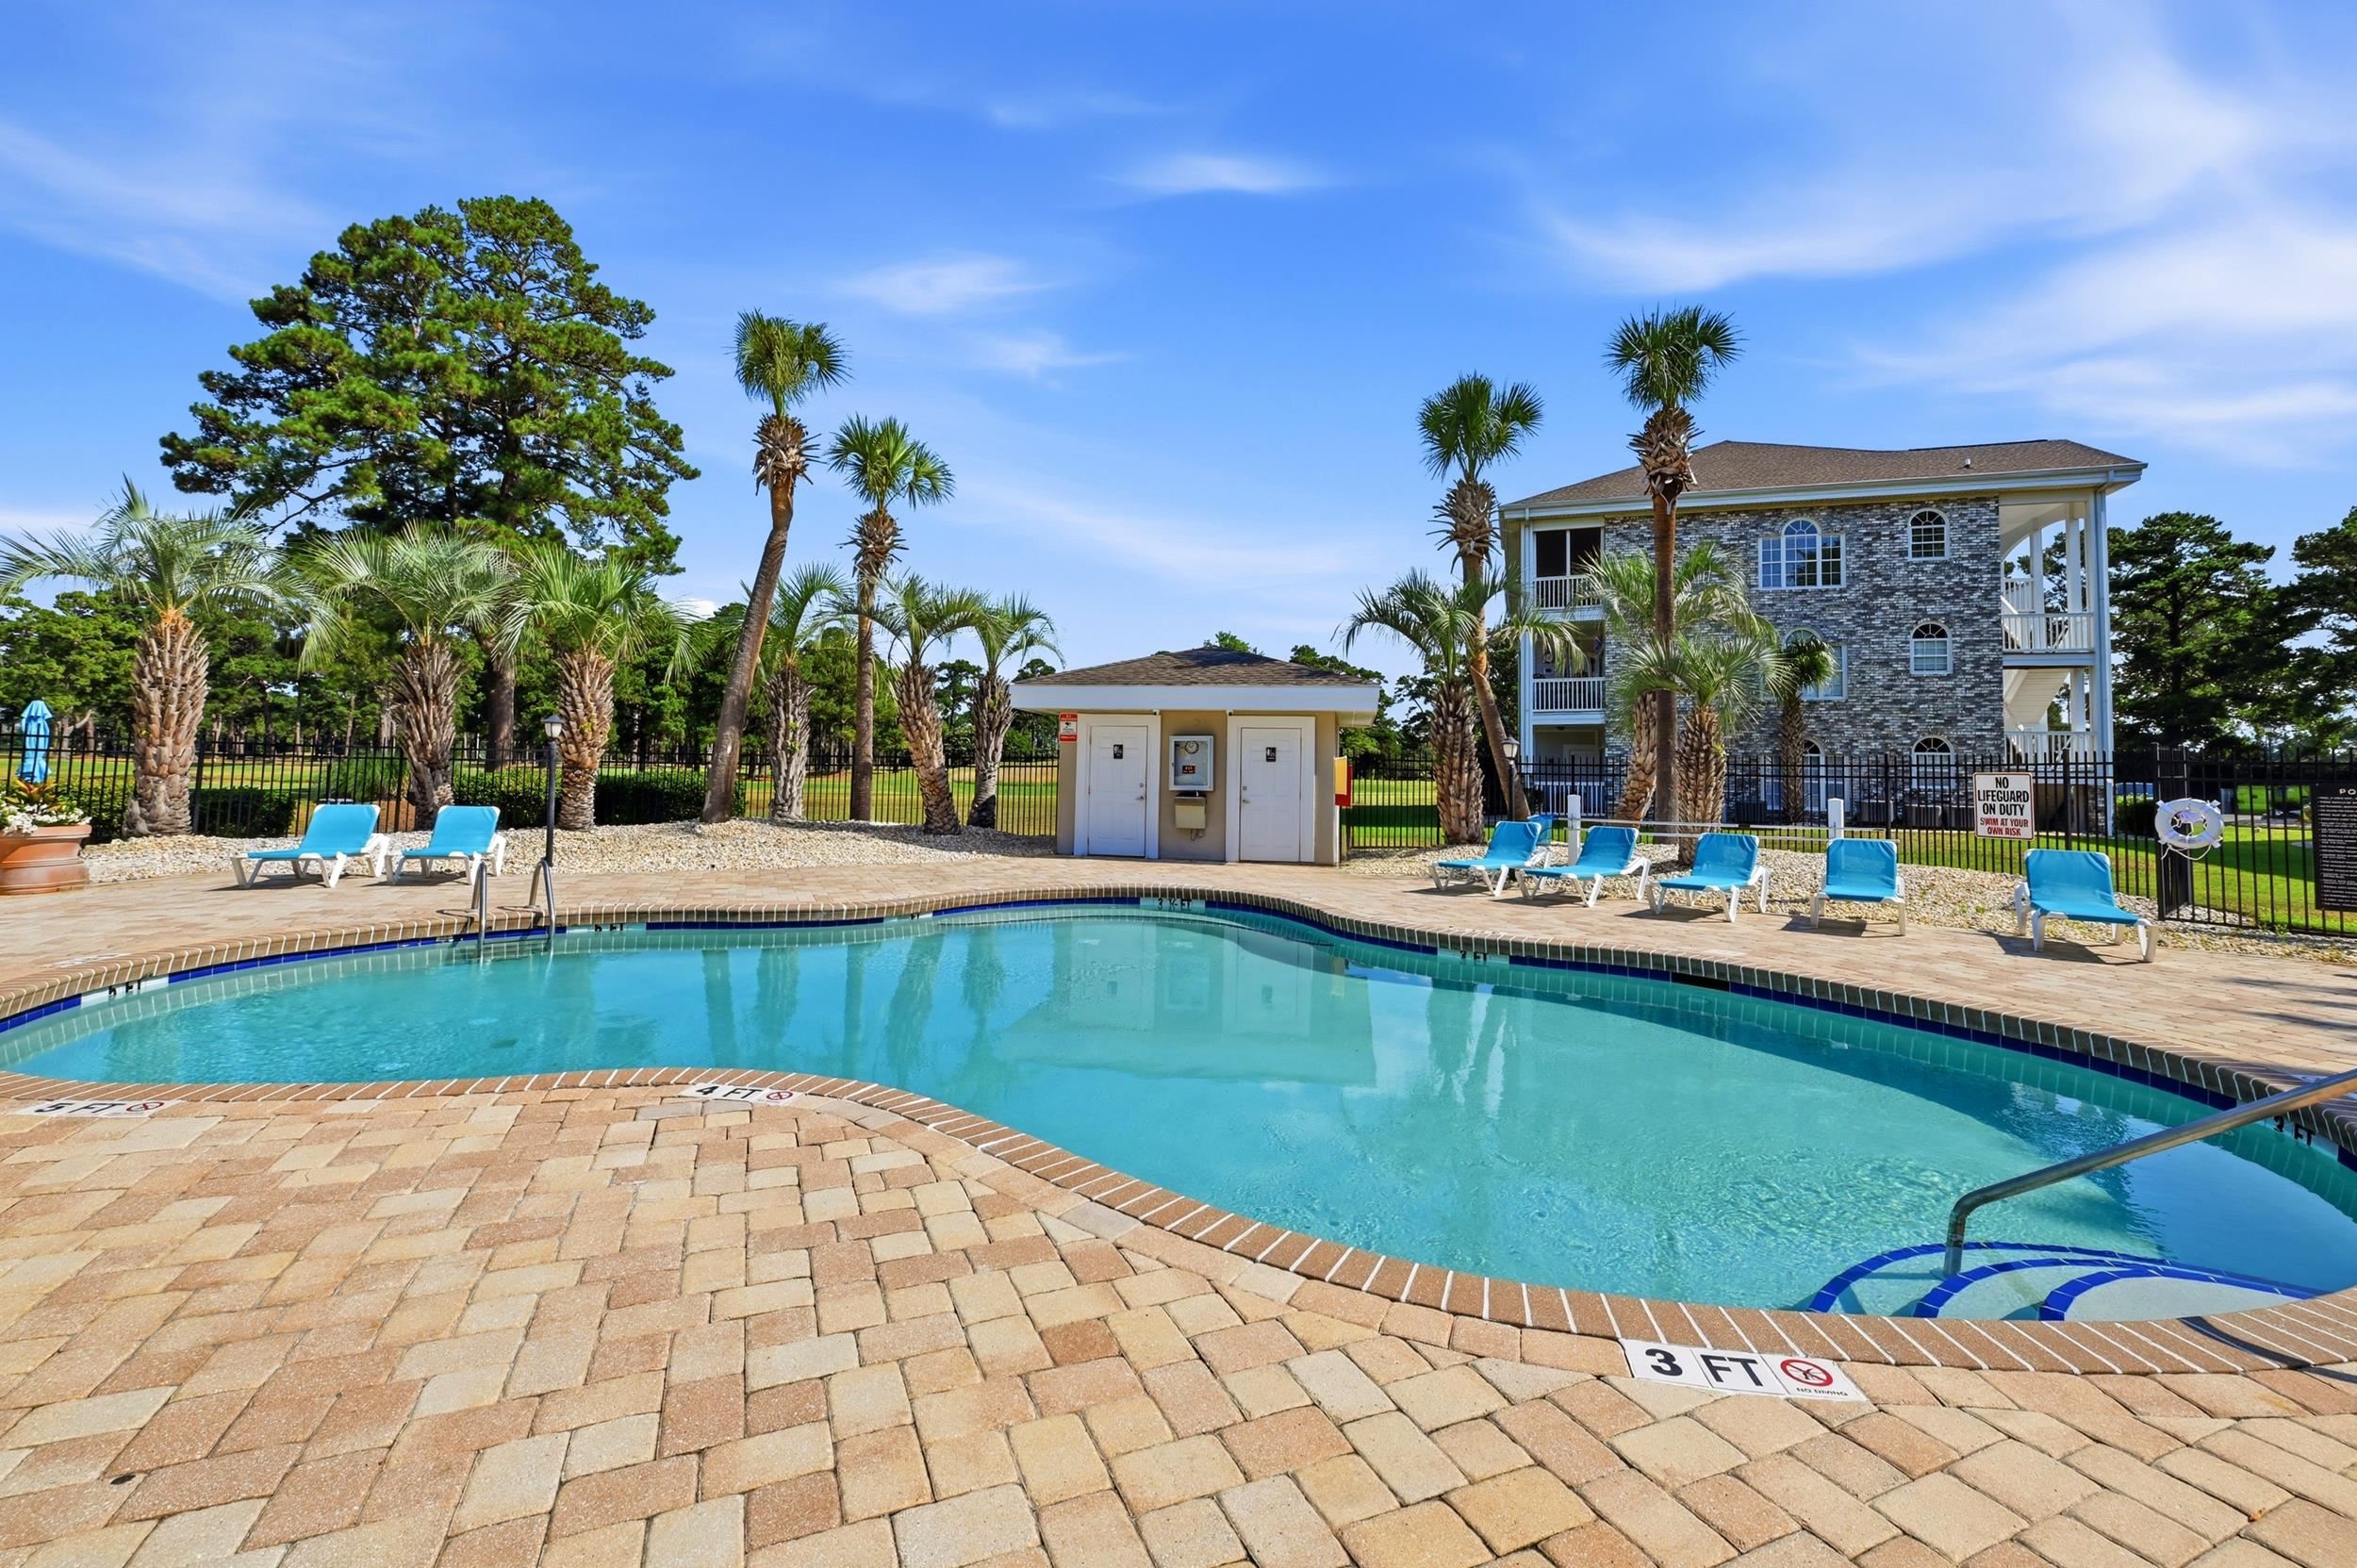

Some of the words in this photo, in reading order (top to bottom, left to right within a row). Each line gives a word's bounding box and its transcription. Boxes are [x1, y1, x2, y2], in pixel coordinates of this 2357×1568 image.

[1995, 777, 2009, 788] NO
[1977, 789, 2030, 802] LIFEGUARD
[1983, 803, 1996, 815] ON
[1999, 803, 2025, 817] DUTY
[1980, 817, 1999, 826] SWIM
[2001, 818, 2008, 827] AT
[2010, 818, 2029, 828] YOUR
[1986, 827, 2003, 835] OWN
[2004, 828, 2021, 836] RISK
[695, 1085, 719, 1096] 4
[722, 1088, 764, 1100] FT
[34, 1102, 74, 1114] 5
[68, 1102, 127, 1114] FT
[1644, 1347, 1684, 1377] 3
[1700, 1354, 1764, 1387] FT
